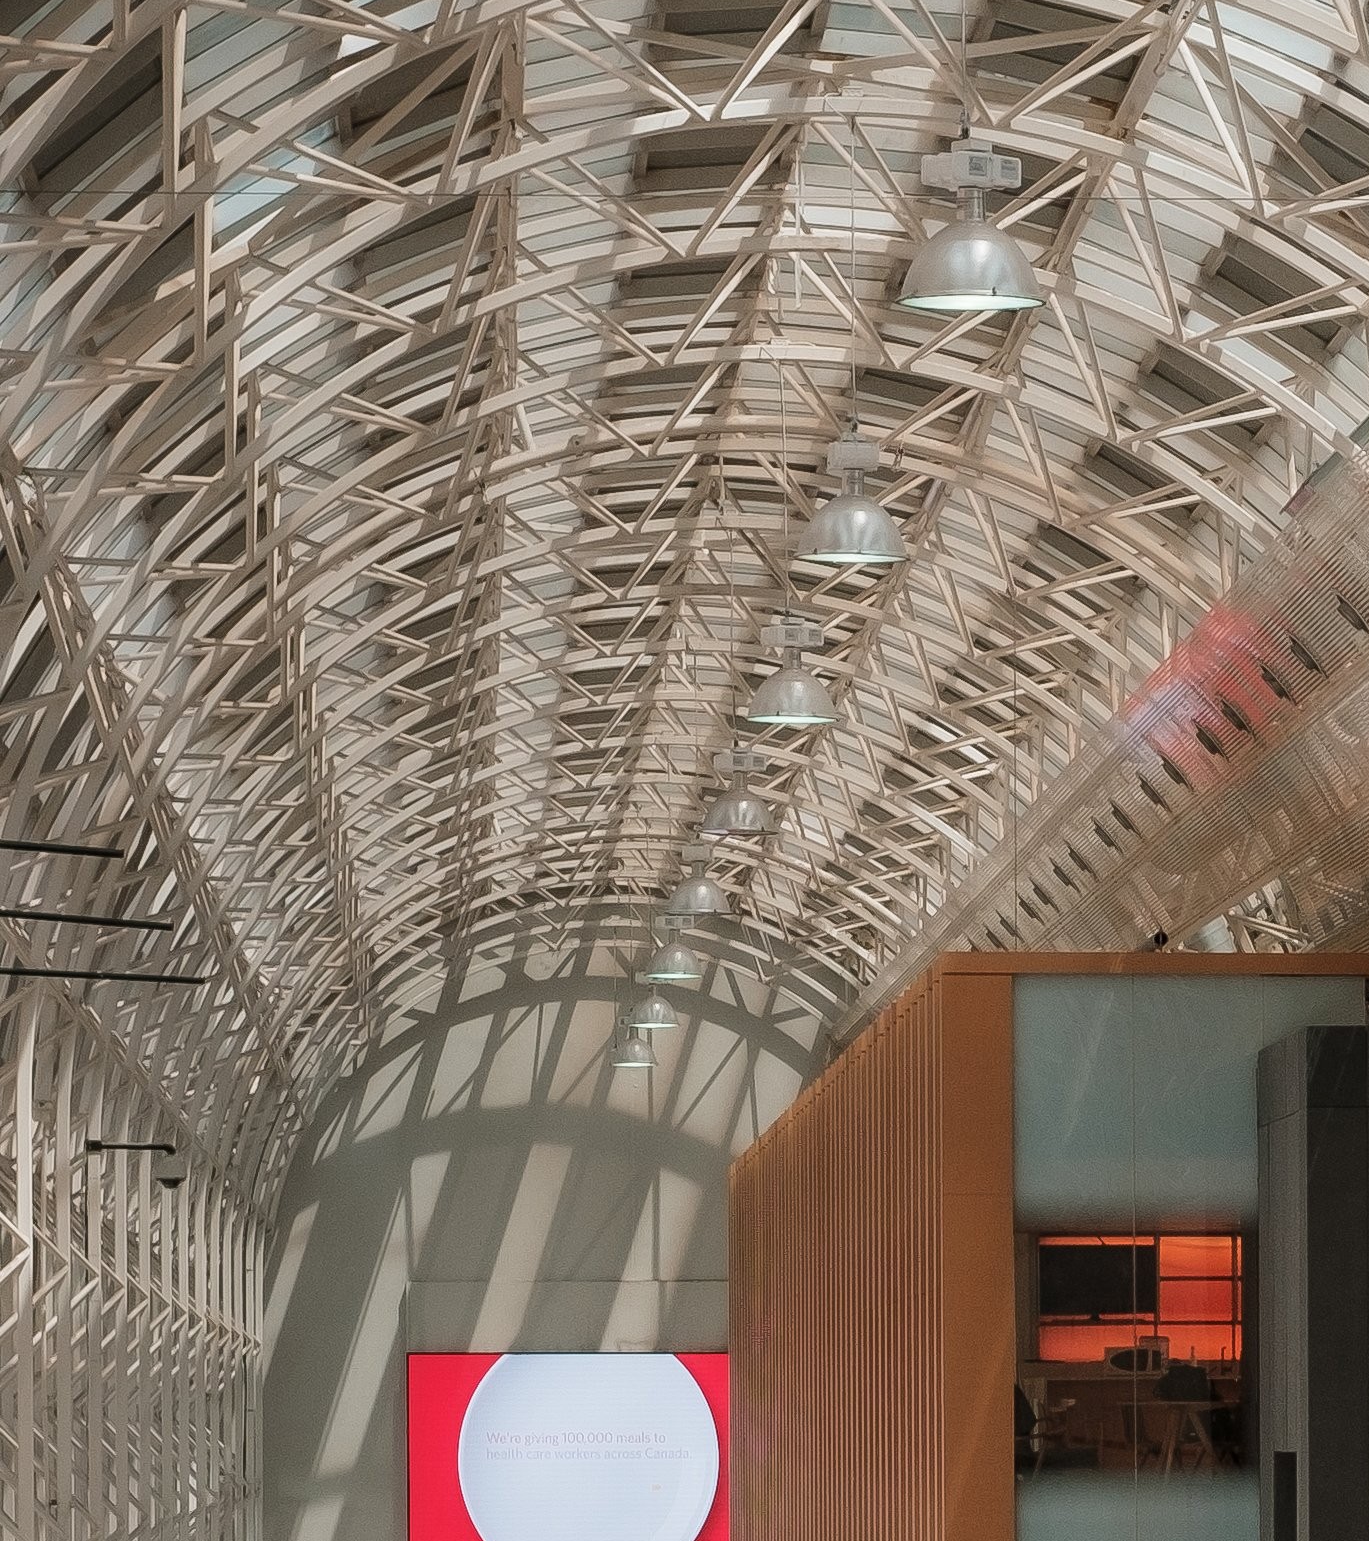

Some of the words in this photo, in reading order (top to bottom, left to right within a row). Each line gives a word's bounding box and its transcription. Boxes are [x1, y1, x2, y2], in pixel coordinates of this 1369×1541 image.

[485, 1431, 522, 1444] We're
[523, 1432, 559, 1447] giving
[560, 1431, 613, 1446] 100,000
[616, 1431, 652, 1444] meals
[652, 1433, 667, 1444] to
[485, 1447, 523, 1460] health
[526, 1450, 552, 1460] care
[554, 1447, 601, 1460] workers
[604, 1450, 642, 1460] across
[644, 1447, 693, 1460] Canada.
